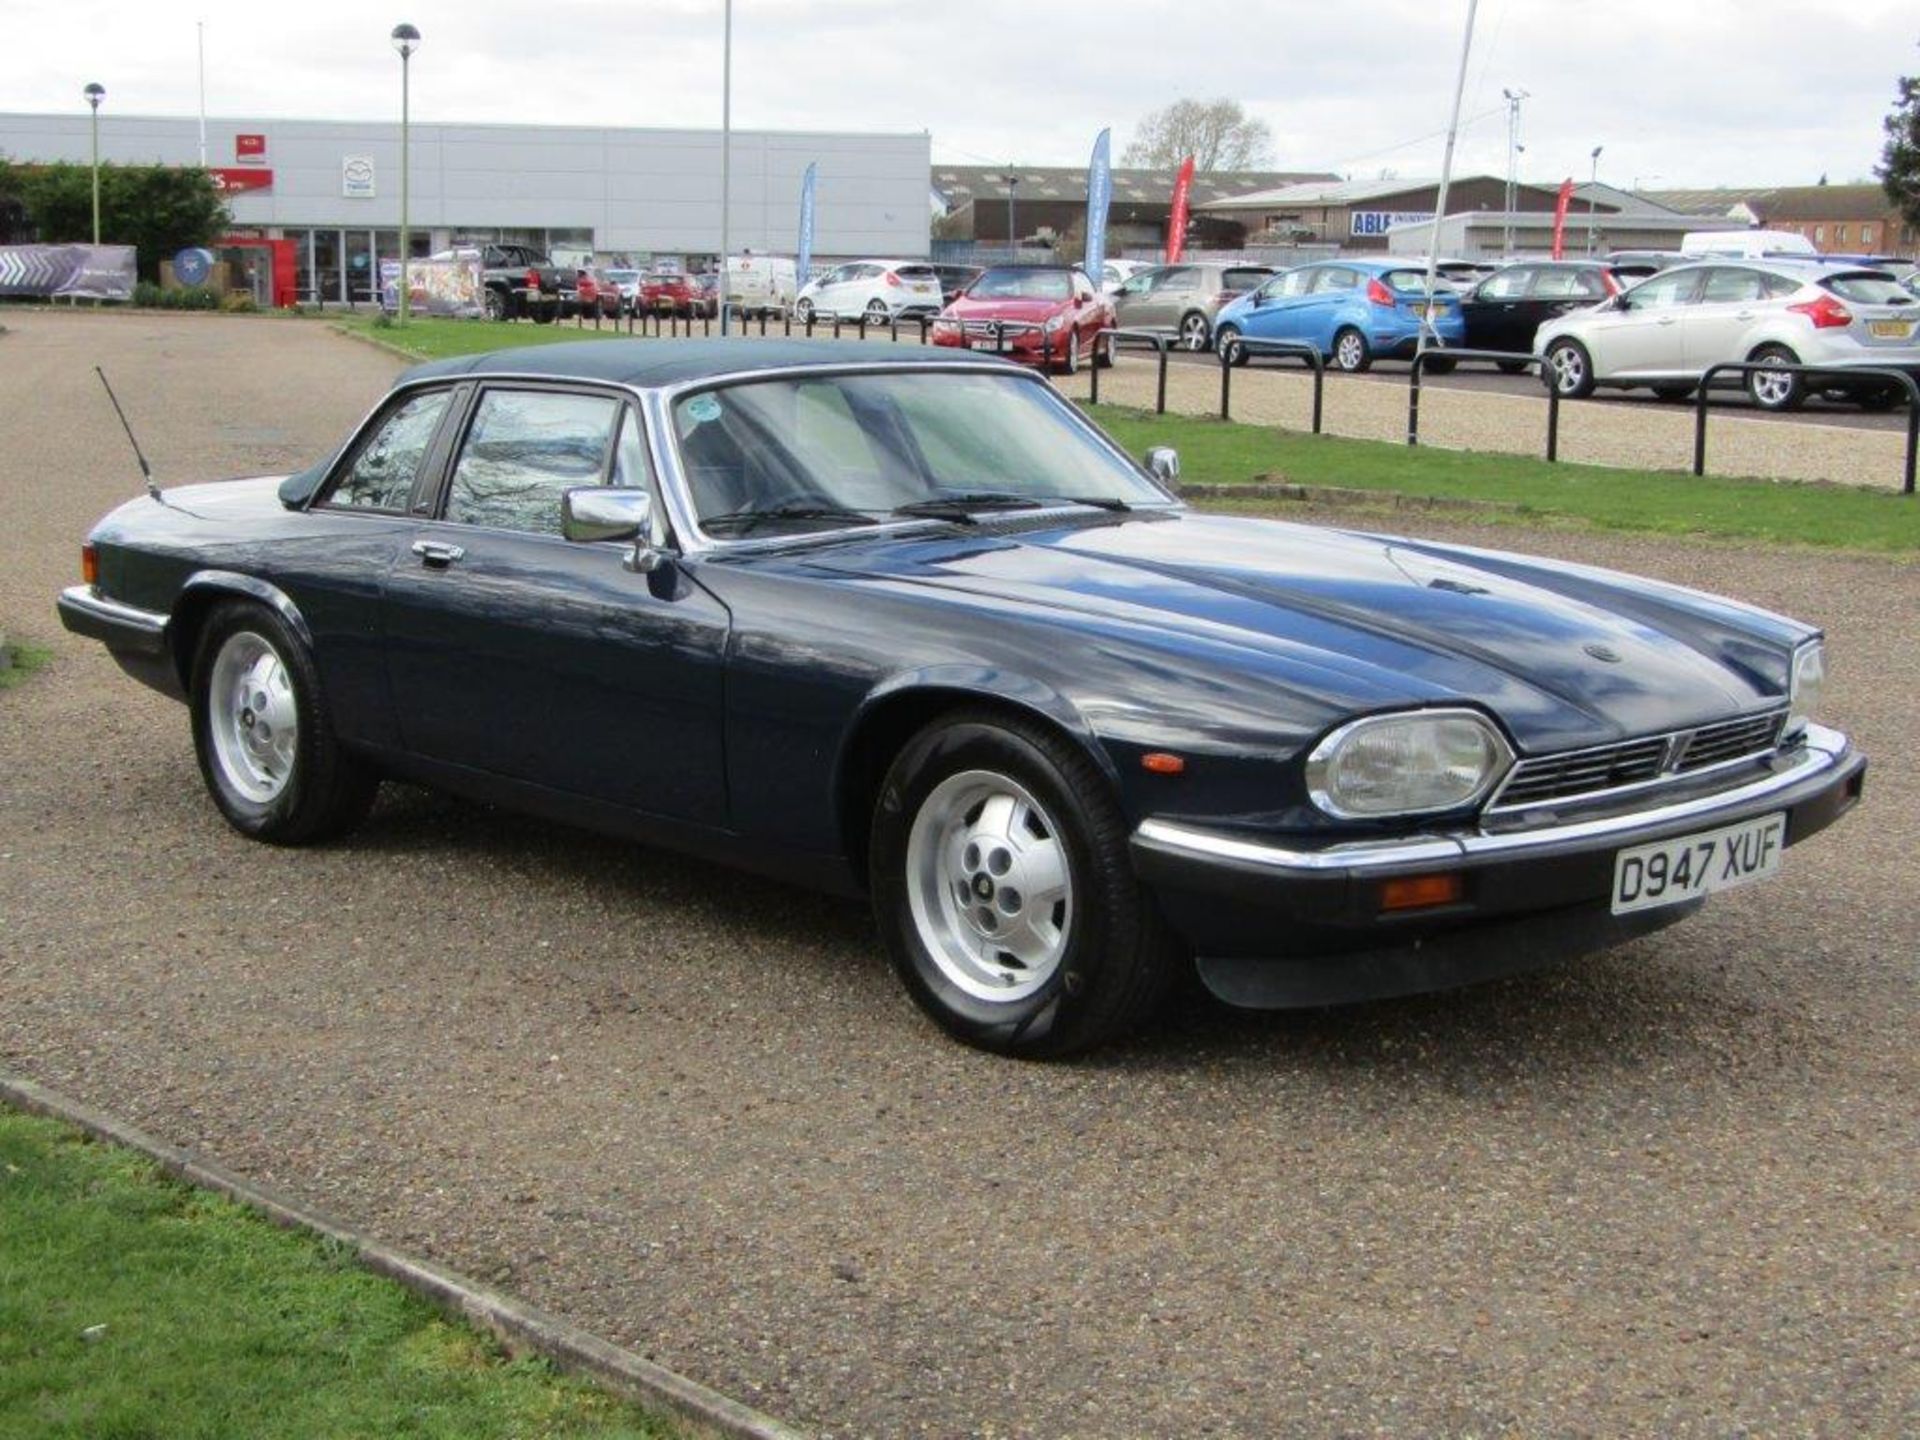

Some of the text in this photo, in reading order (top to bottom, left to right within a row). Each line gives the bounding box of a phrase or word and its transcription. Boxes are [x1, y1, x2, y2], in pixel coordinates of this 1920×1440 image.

[1353, 213, 1391, 234] ABLE
[1619, 822, 1780, 903] D947 XUF
